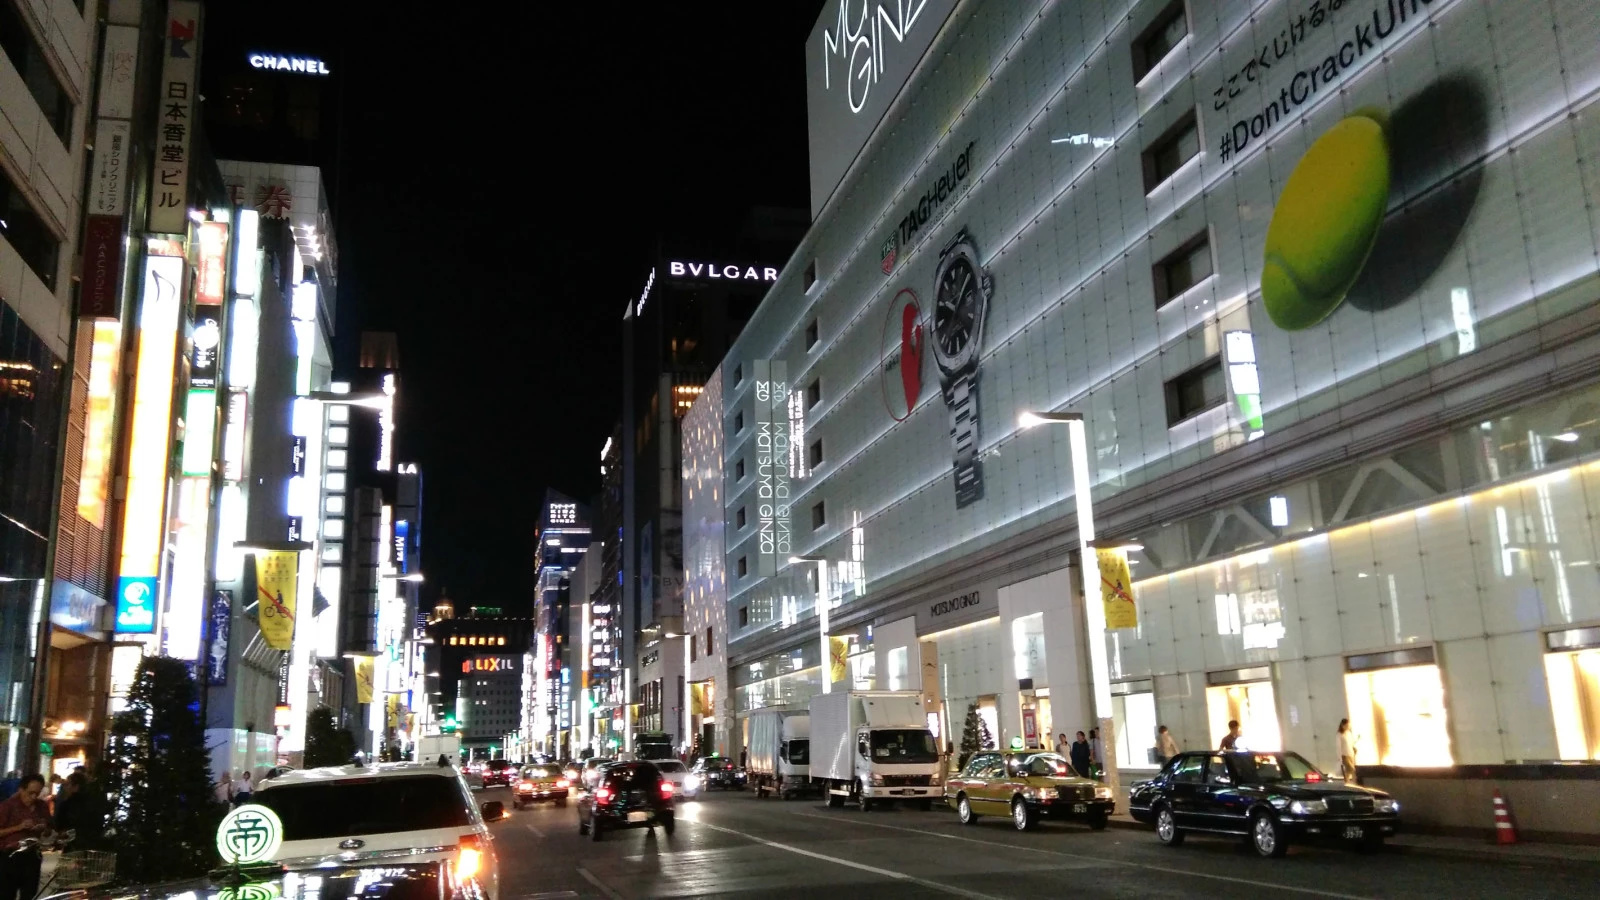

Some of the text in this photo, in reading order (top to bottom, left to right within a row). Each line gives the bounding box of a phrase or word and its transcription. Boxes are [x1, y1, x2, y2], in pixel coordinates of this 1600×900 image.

[249, 54, 329, 75] CHANEL
[1219, 0, 1433, 164] #DontCrackUn
[159, 82, 187, 208] 日本香堂ビル
[475, 658, 514, 671] LIXIL
